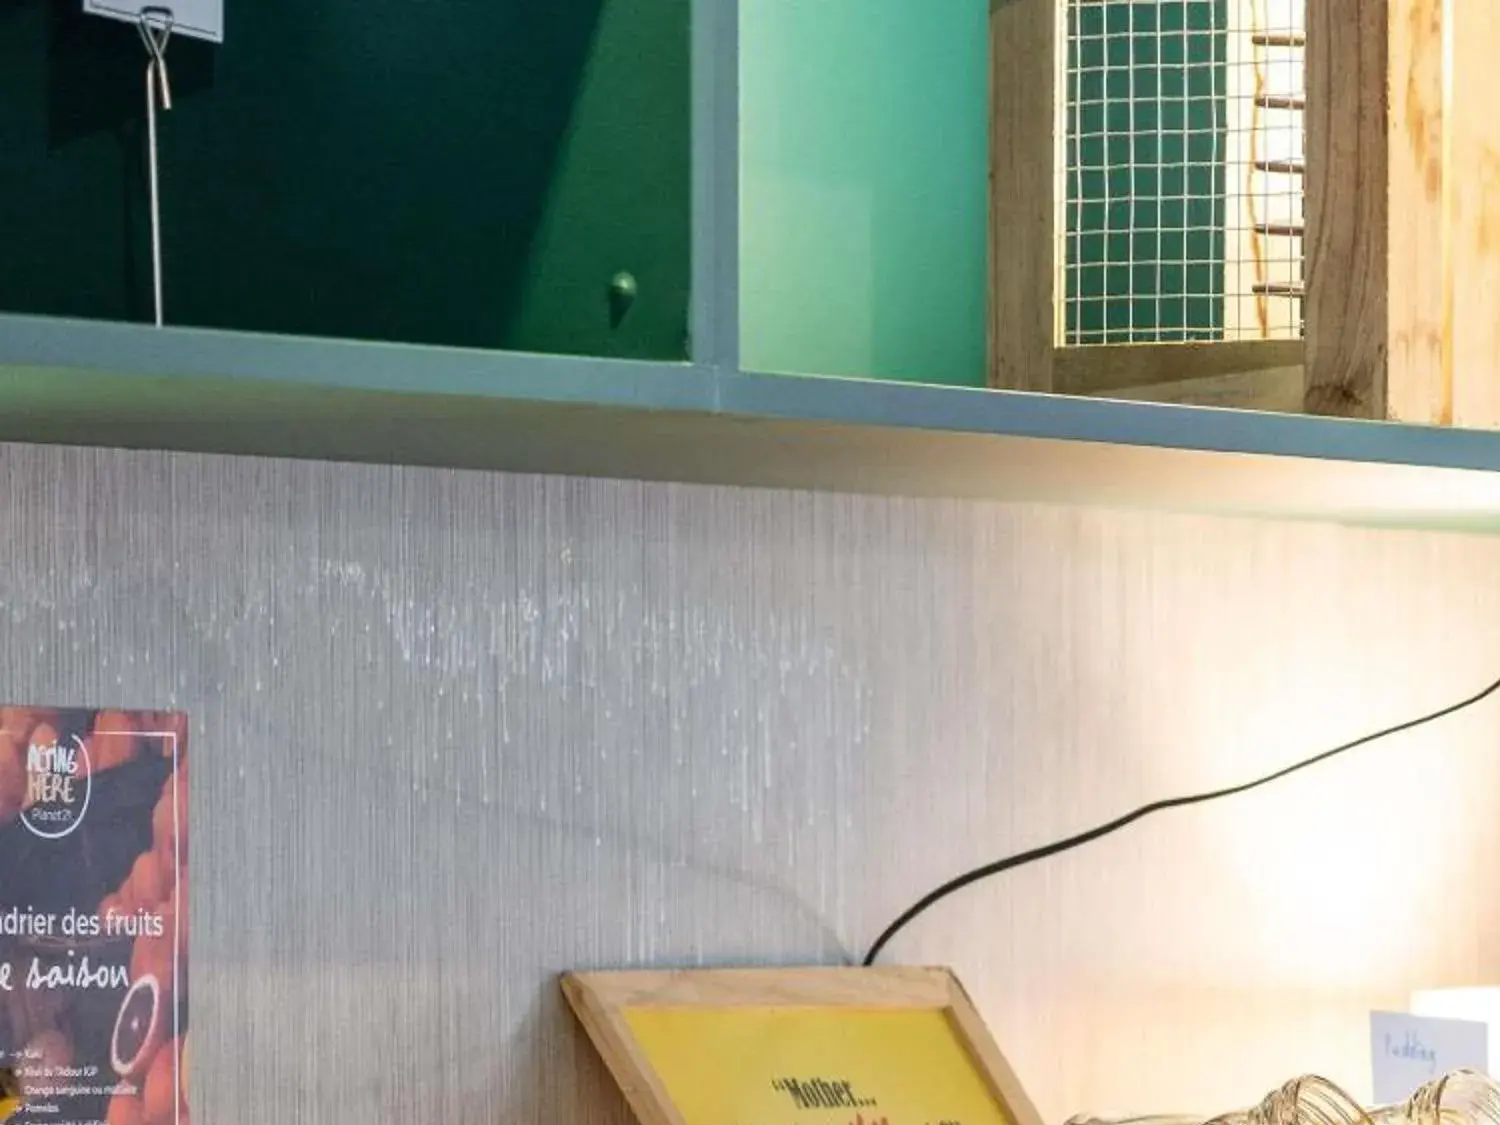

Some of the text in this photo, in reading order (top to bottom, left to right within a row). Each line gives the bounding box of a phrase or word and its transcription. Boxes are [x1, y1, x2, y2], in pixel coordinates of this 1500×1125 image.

[28, 773, 76, 803] HERE
[61, 906, 100, 937] des
[106, 907, 164, 937] fruits
[26, 949, 130, 989] saison
